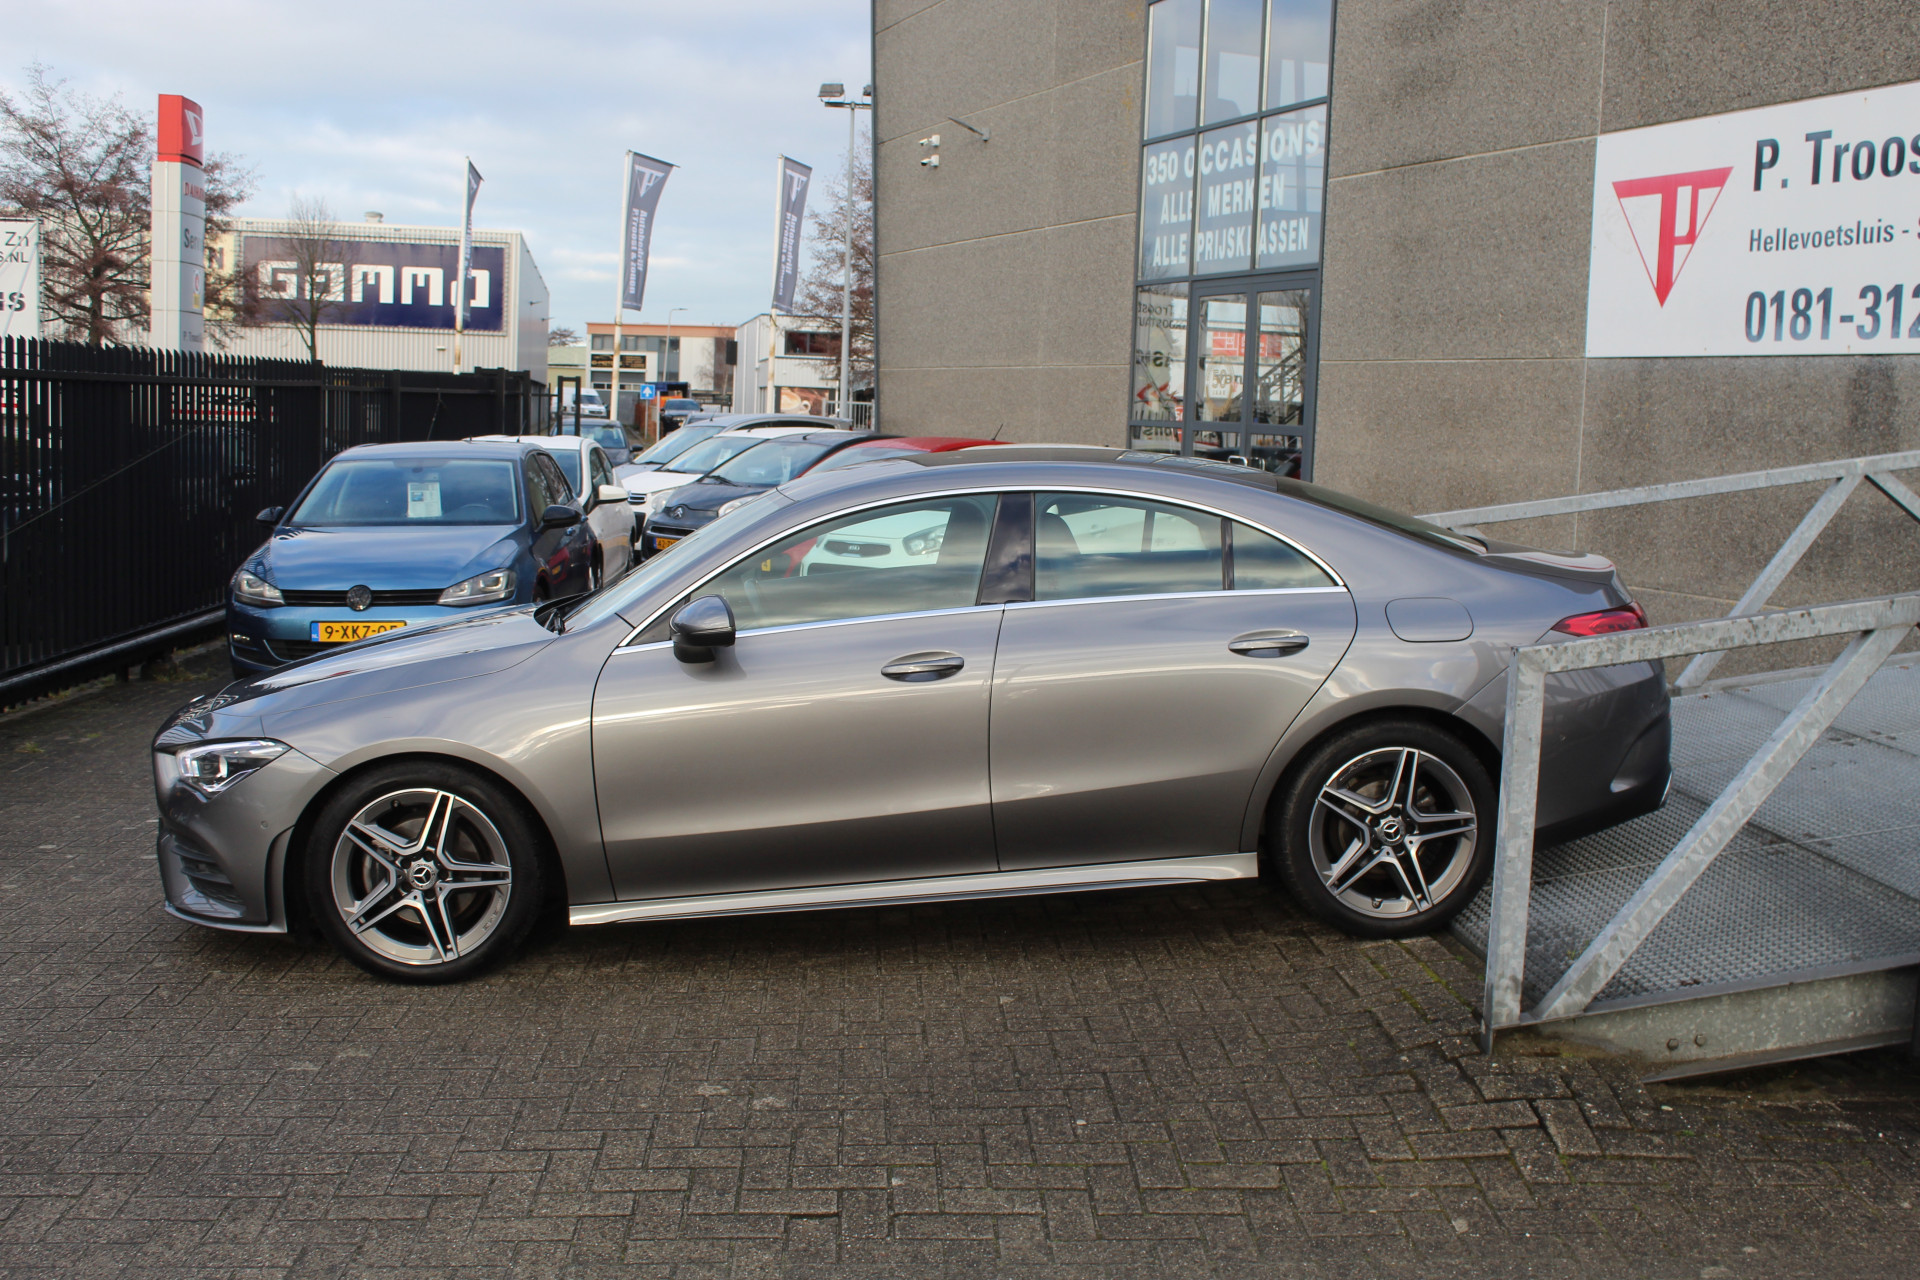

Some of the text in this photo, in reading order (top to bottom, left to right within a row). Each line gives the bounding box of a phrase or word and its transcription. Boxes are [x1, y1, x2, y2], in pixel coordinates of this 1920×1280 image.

[1147, 119, 1321, 186] 350 OCCASIONS
[1753, 138, 1788, 192] P.
[1160, 173, 1285, 225] ALLE MERKEN
[1153, 233, 1188, 267] ALLE
[1749, 218, 1895, 253] Hellevoetsluis
